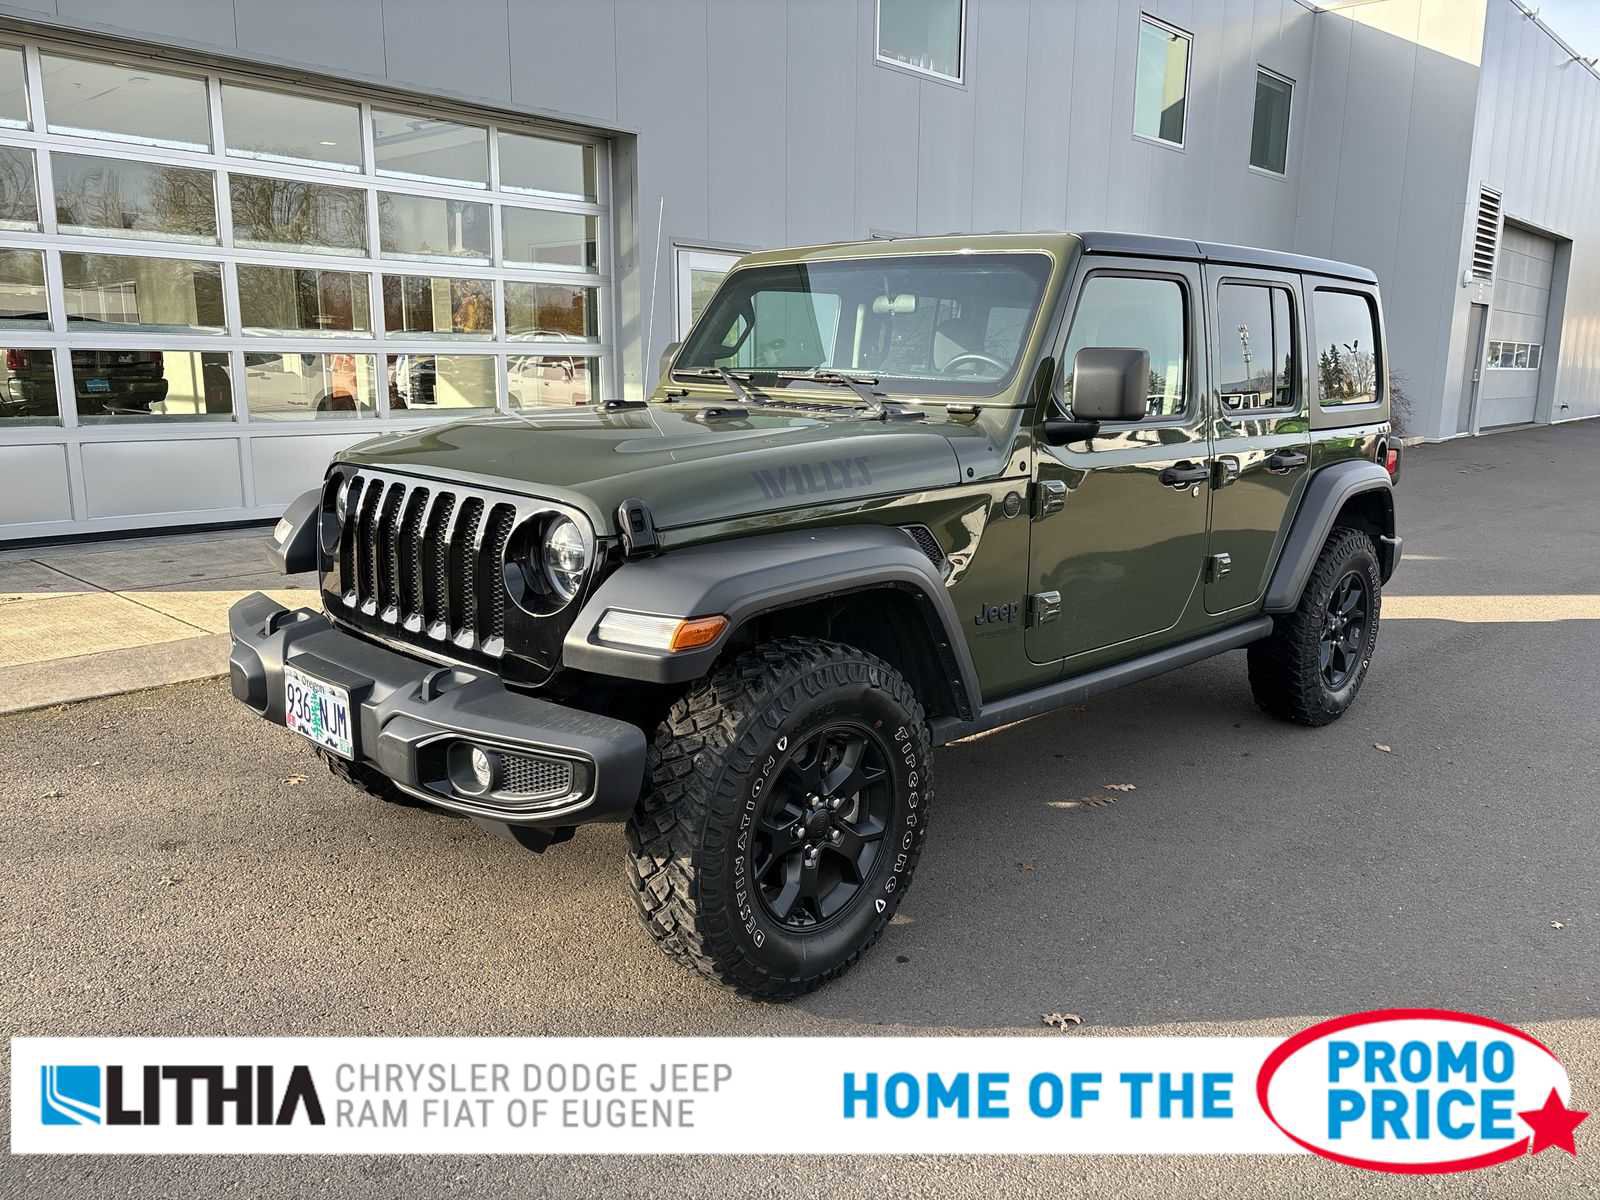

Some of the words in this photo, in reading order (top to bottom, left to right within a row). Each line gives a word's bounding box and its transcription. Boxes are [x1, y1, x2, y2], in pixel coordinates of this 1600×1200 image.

[751, 456, 873, 499] WILLYS
[975, 602, 1018, 625] Jeep
[287, 683, 311, 723] 936
[320, 697, 347, 740] NJM
[735, 755, 776, 948] DESTINATION
